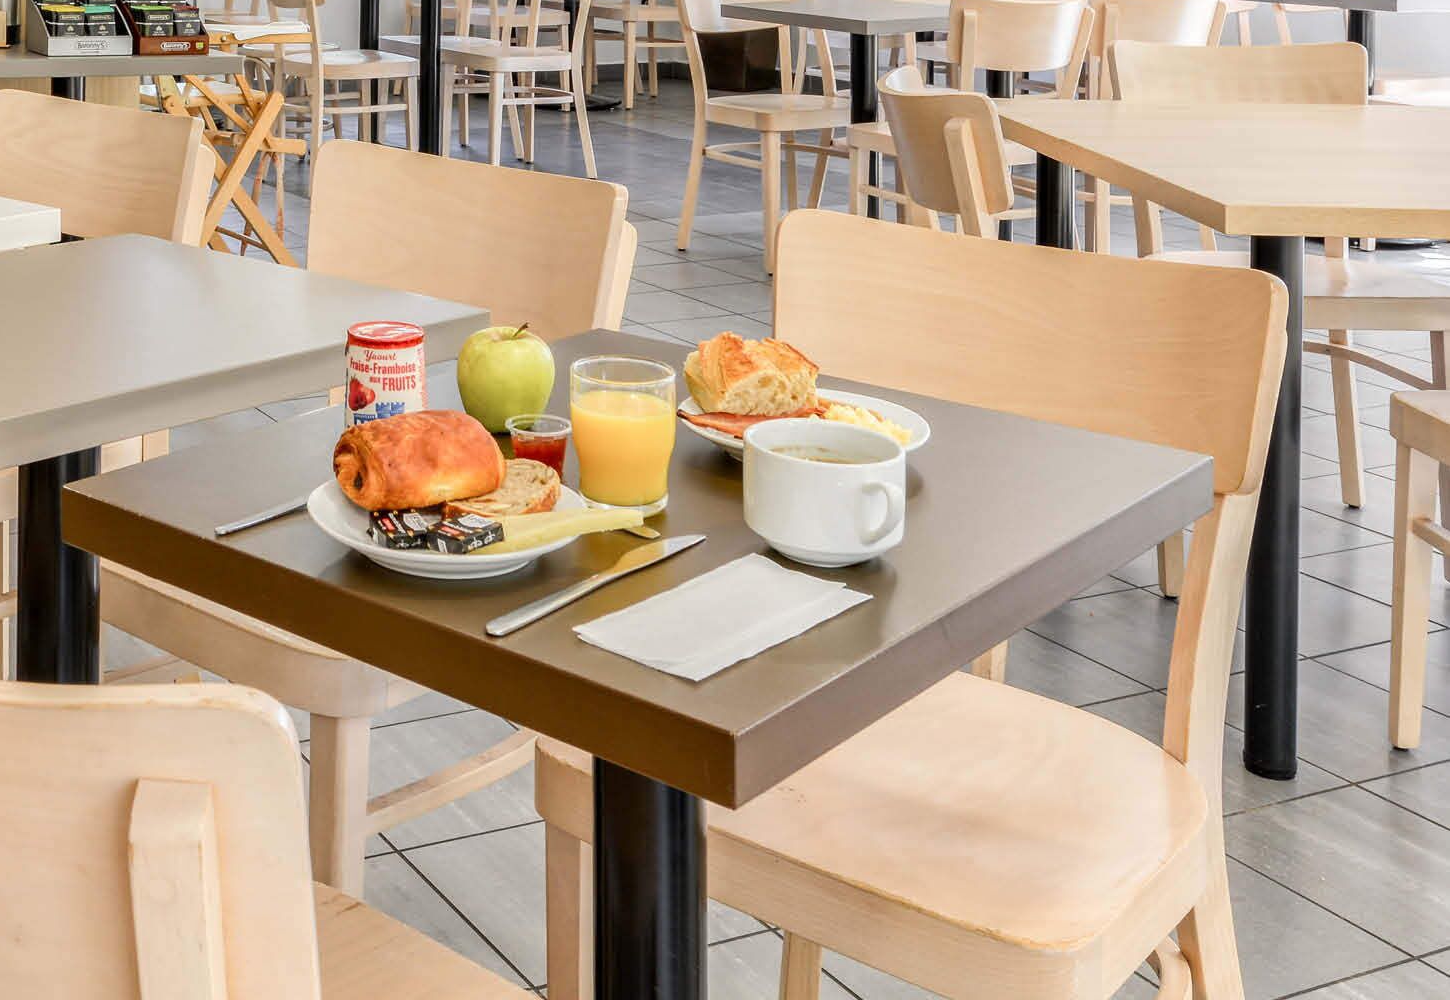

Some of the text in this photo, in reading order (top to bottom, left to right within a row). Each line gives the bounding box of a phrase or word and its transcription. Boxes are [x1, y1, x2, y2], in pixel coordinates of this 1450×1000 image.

[364, 349, 397, 361] Yaourt
[350, 357, 416, 375] Fraise-Framboise
[382, 374, 416, 392] FRUITS
